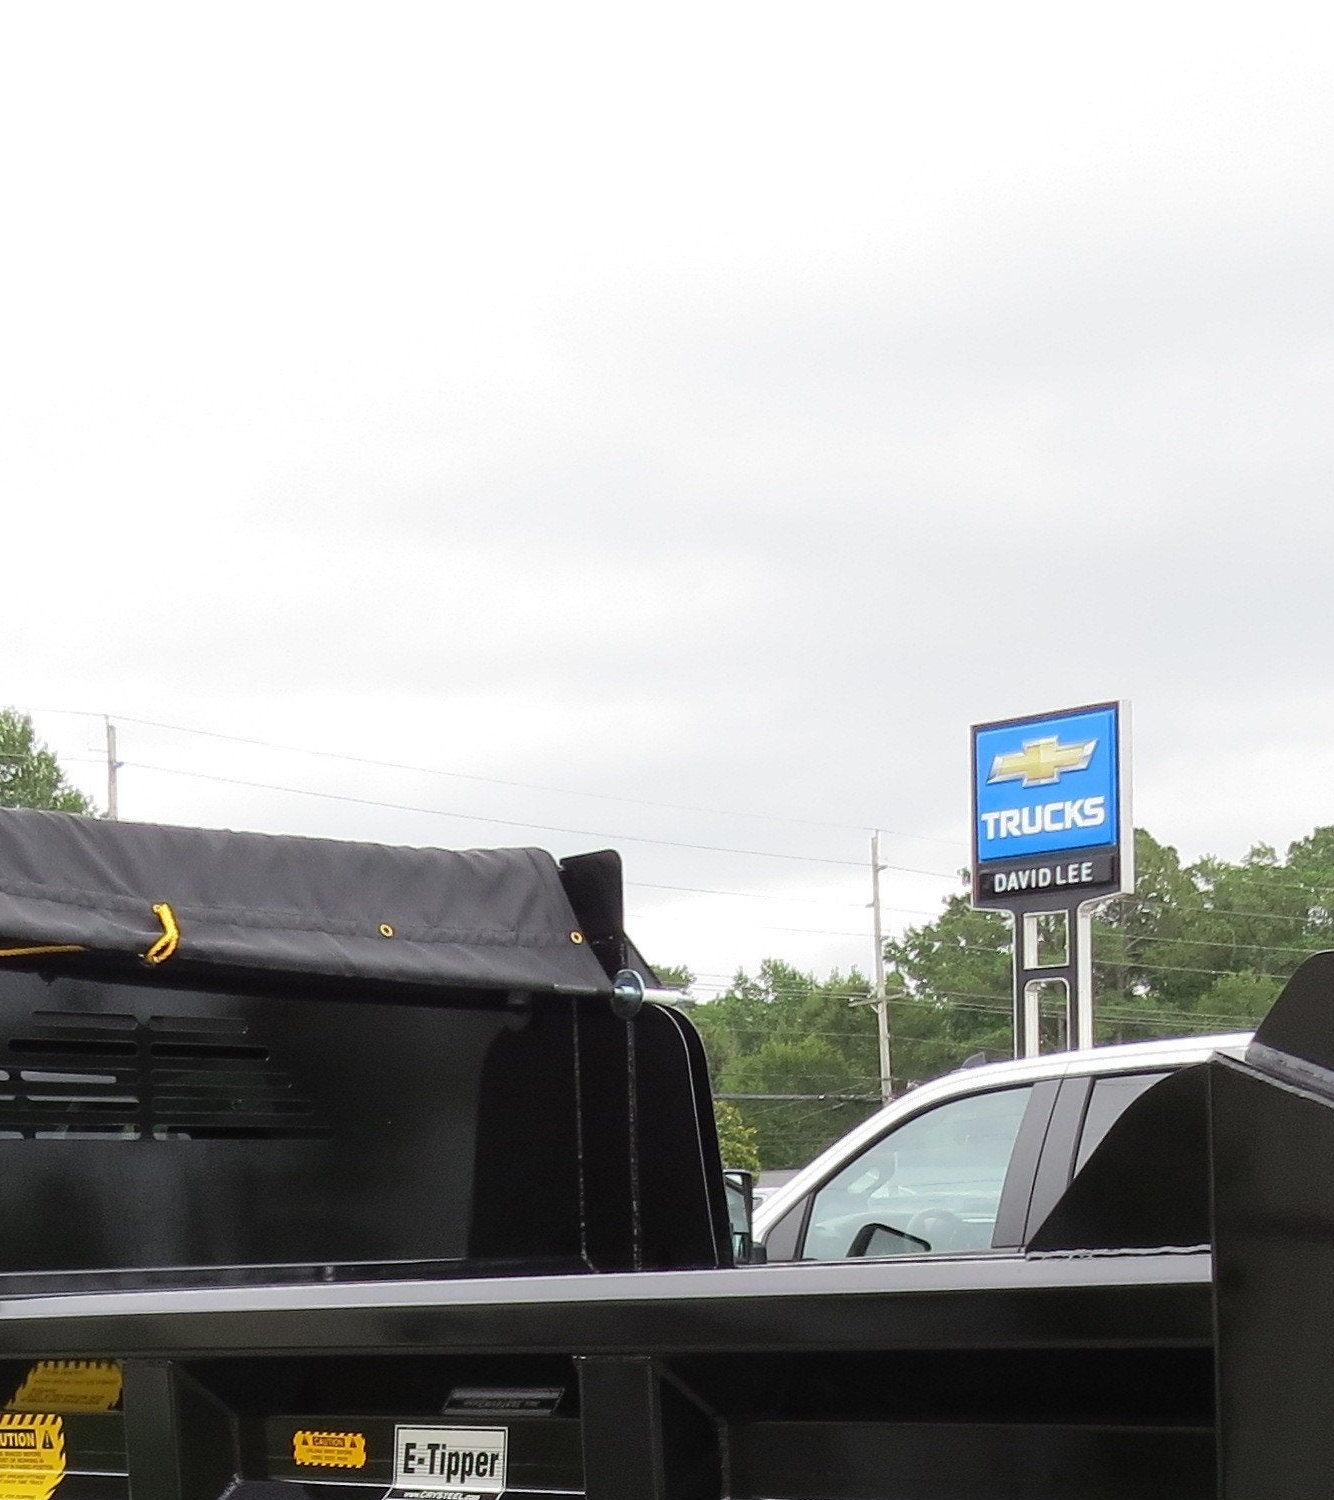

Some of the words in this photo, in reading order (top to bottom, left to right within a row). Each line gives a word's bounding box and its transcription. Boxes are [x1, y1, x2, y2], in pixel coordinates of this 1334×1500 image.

[981, 796, 1105, 841] TRUCKS
[993, 867, 1052, 894] DAVID
[1056, 861, 1094, 885] LEE
[403, 1443, 499, 1483] E-Tipper
